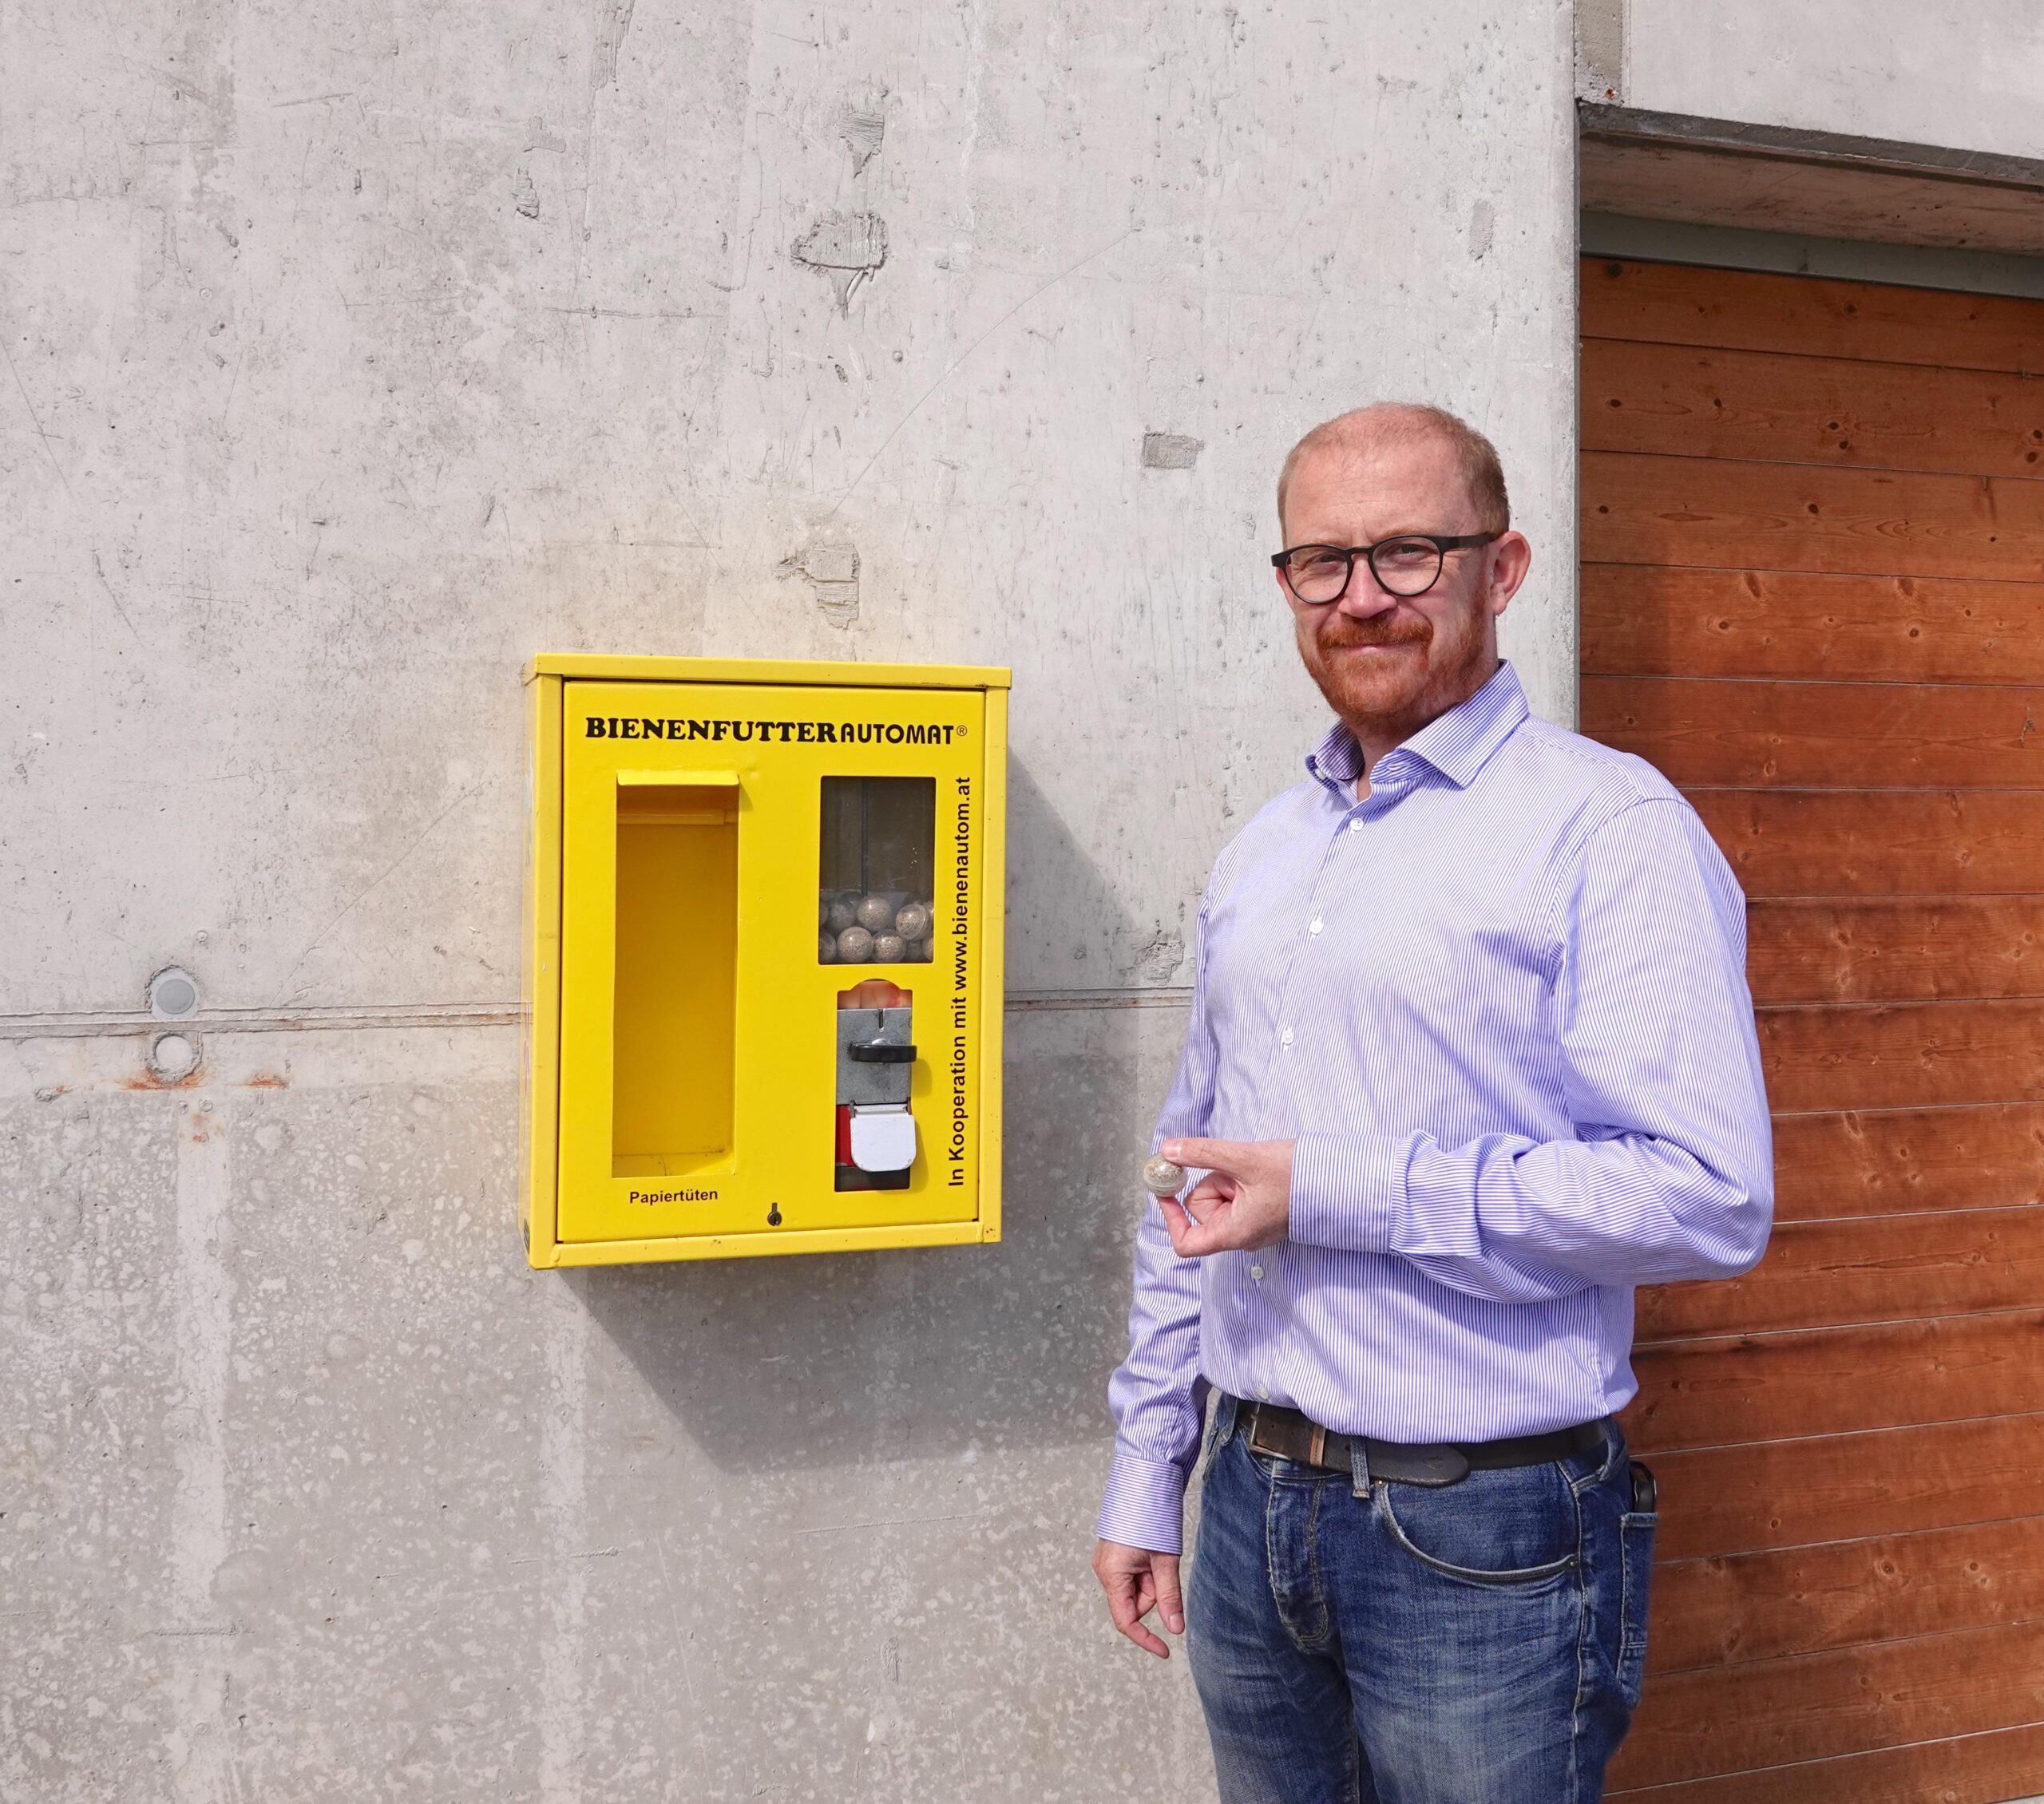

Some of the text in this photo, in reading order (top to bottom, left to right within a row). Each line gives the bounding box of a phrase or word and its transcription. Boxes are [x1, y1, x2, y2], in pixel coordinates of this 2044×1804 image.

[947, 776, 971, 1187] In Kooperation mit www.bienenautom.at
[629, 1188, 719, 1207] Papiertüten
